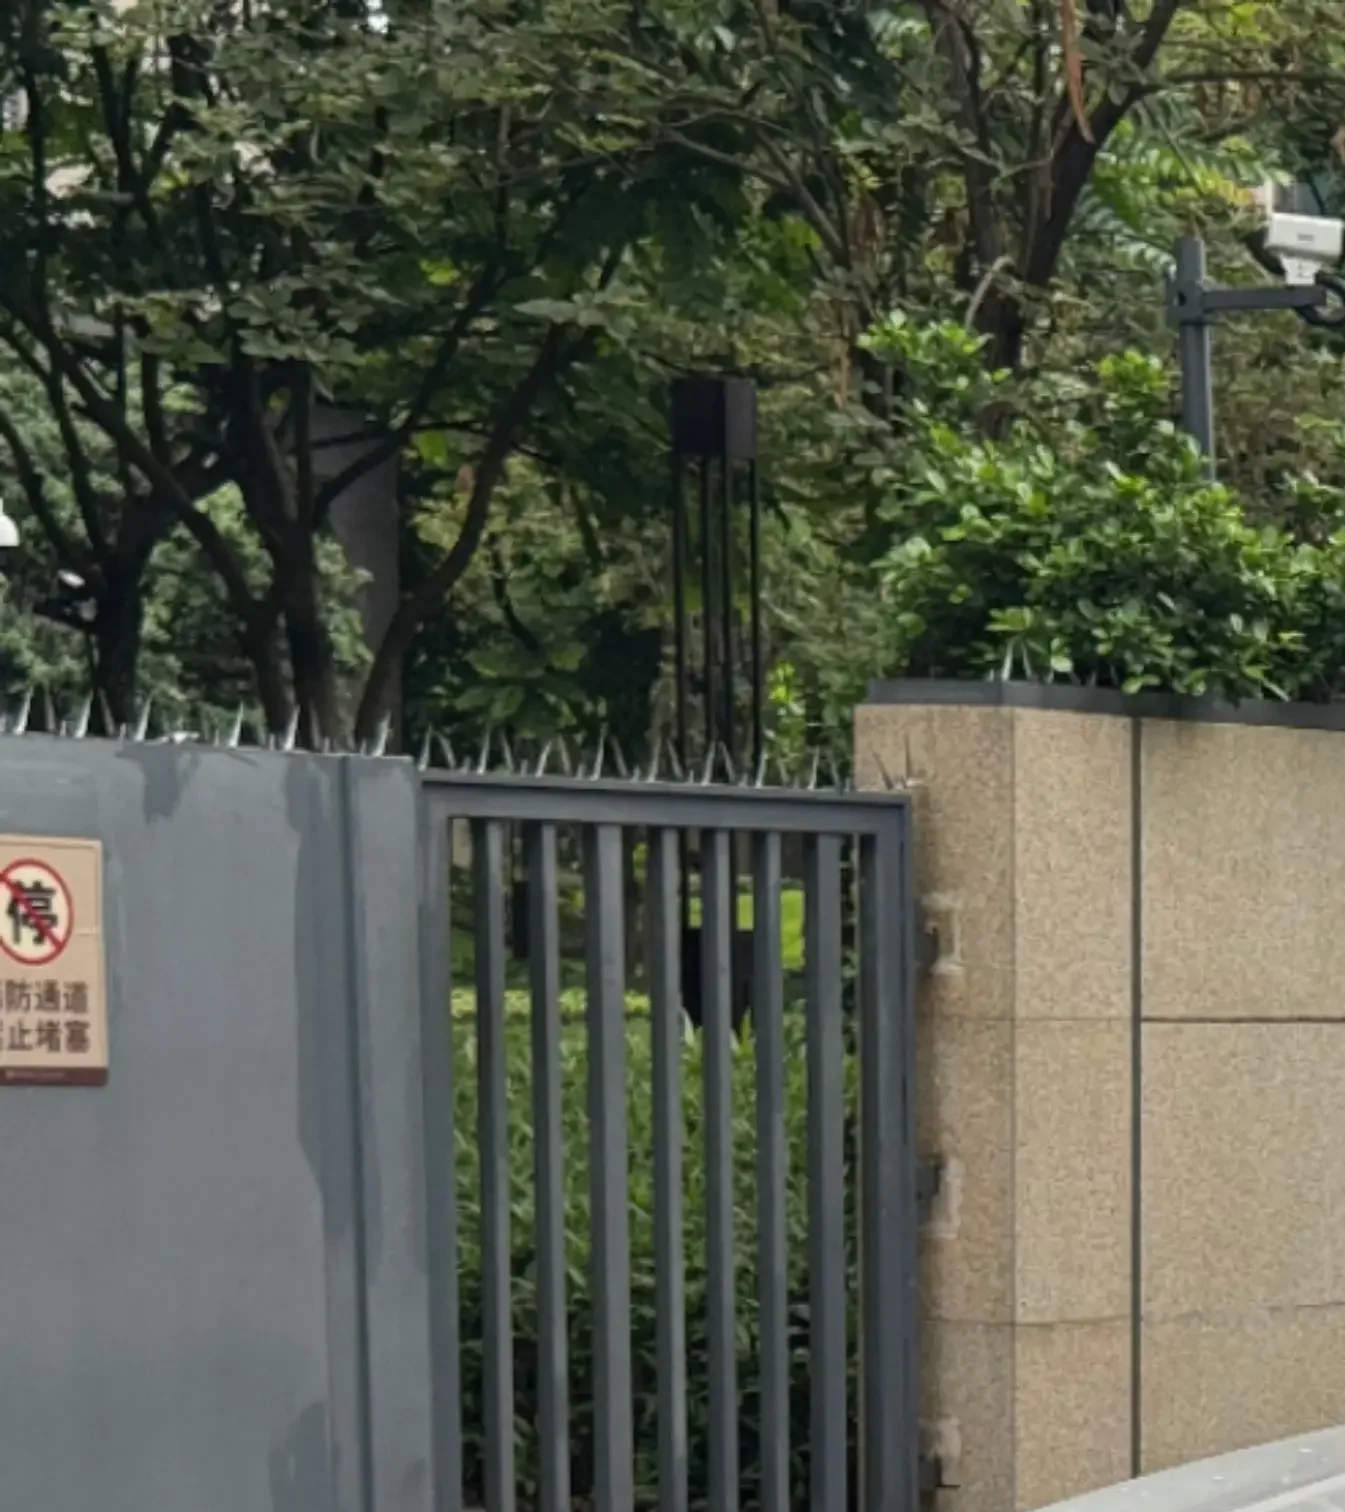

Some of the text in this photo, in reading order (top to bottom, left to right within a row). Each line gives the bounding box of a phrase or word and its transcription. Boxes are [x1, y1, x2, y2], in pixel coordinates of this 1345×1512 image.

[0, 978, 89, 1014] 防通道
[0, 1019, 91, 1053] 止堵塞
